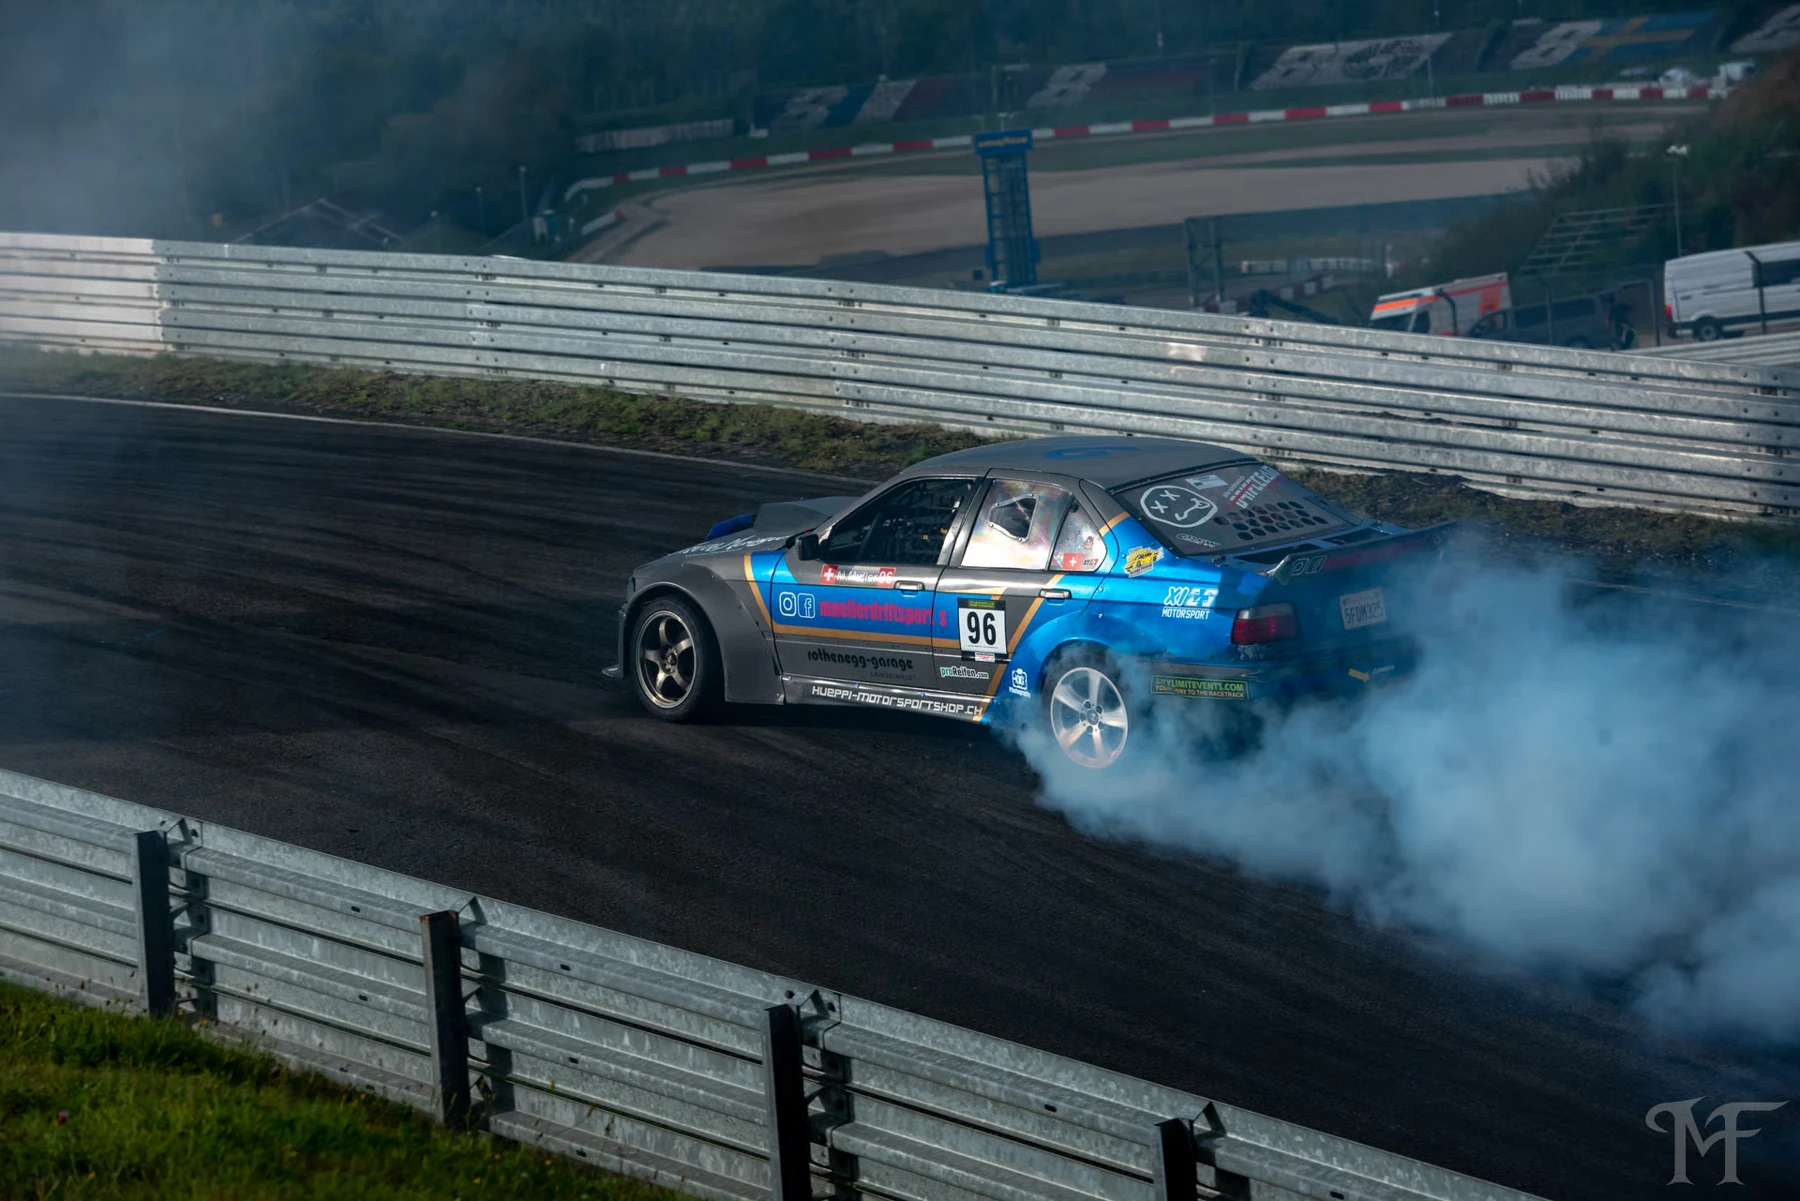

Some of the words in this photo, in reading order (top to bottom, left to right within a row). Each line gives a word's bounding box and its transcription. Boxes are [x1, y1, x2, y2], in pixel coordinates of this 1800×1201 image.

[1161, 608, 1211, 620] MOTORSPORT
[967, 611, 996, 645] 96
[807, 648, 913, 671] rothenegg-garage
[940, 666, 989, 681] proReifen.com
[1208, 690, 1245, 698] RACETRACK
